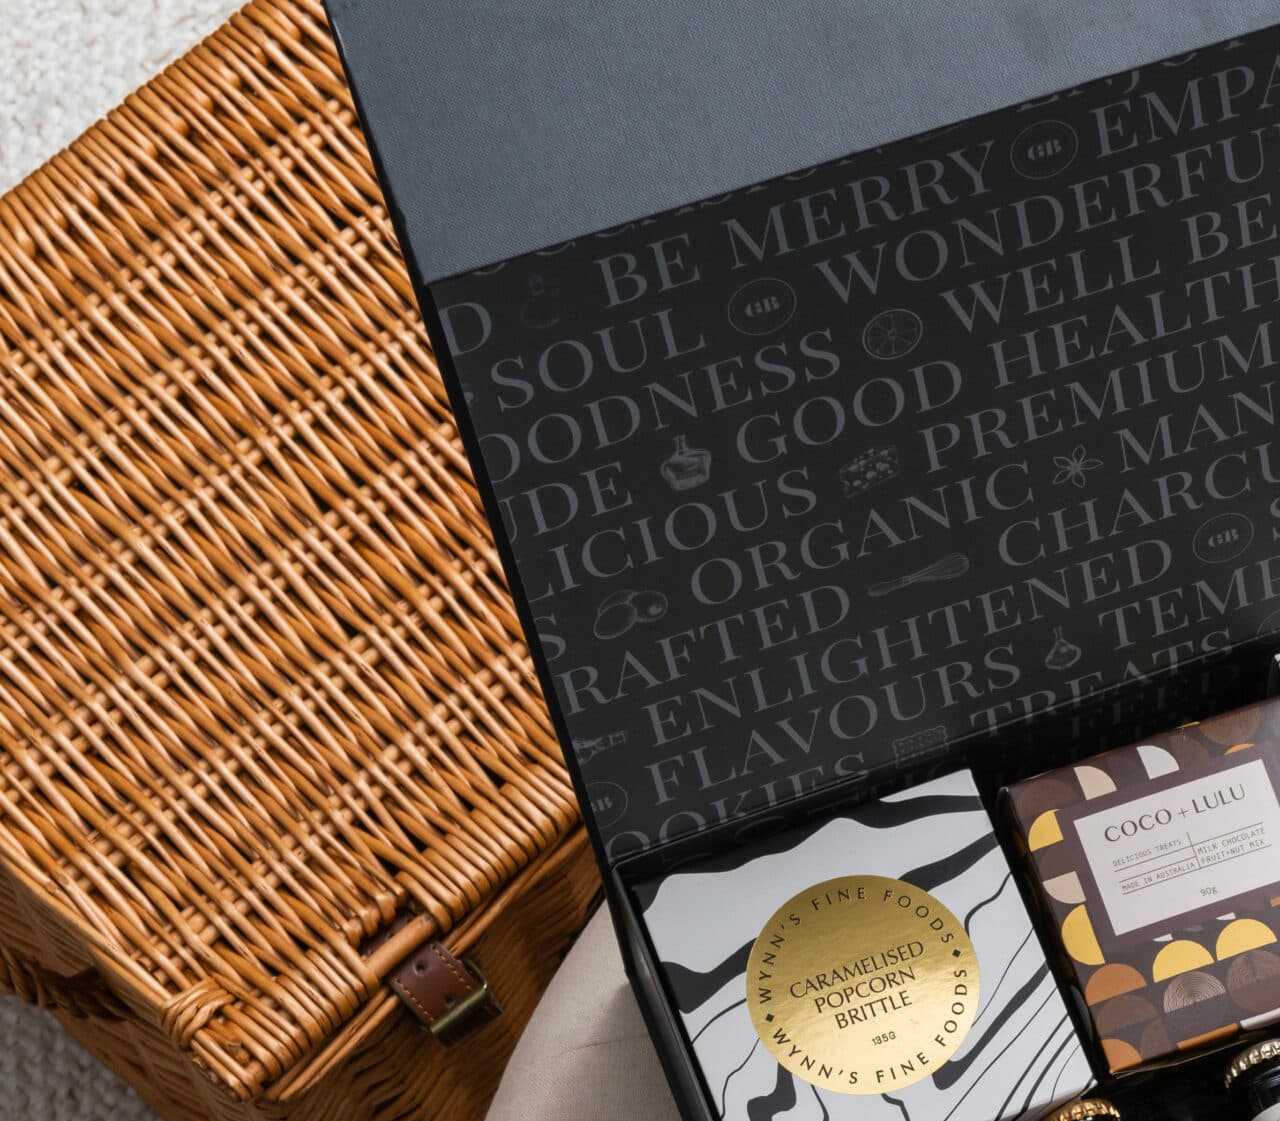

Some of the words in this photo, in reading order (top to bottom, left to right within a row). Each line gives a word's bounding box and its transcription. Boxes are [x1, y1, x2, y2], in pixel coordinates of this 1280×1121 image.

[593, 232, 701, 309] BE
[720, 139, 997, 270] MERRY
[939, 233, 1161, 335] WELL
[489, 308, 707, 412] SOUL
[917, 320, 1279, 474] PREMIUM
[736, 360, 963, 465] GOOD
[691, 461, 1034, 605] ORGANIC
[1114, 381, 1277, 474] MAN
[554, 584, 851, 716] RAFTED
[641, 538, 1173, 748] ENLIGHTENED
[645, 641, 1022, 806] FLAVOURS
[1103, 808, 1173, 843] COCO
[1191, 783, 1247, 815] LULU
[1112, 847, 1152, 868] DELICIOUS
[1155, 839, 1183, 854] TREATS
[1197, 842, 1219, 856] MILK
[1221, 826, 1267, 848] CHOCOLATE
[1248, 838, 1266, 850] MIX
[1121, 879, 1142, 892] MADE
[1143, 875, 1154, 885] IN
[1155, 861, 1196, 881] AUSTRALIA
[1200, 885, 1219, 897] 90g
[758, 912, 801, 1005] WYNN'S
[811, 887, 866, 911] FINE
[883, 889, 955, 944] FOODS
[789, 940, 925, 999] CARAMELISED
[814, 966, 917, 1014] POPCORN
[772, 1028, 858, 1085] WYNN'S
[876, 1051, 930, 1084] FINE
[934, 968, 969, 1048] FOODS
[834, 990, 913, 1030] BRITTLE
[871, 1031, 897, 1046] 135G
